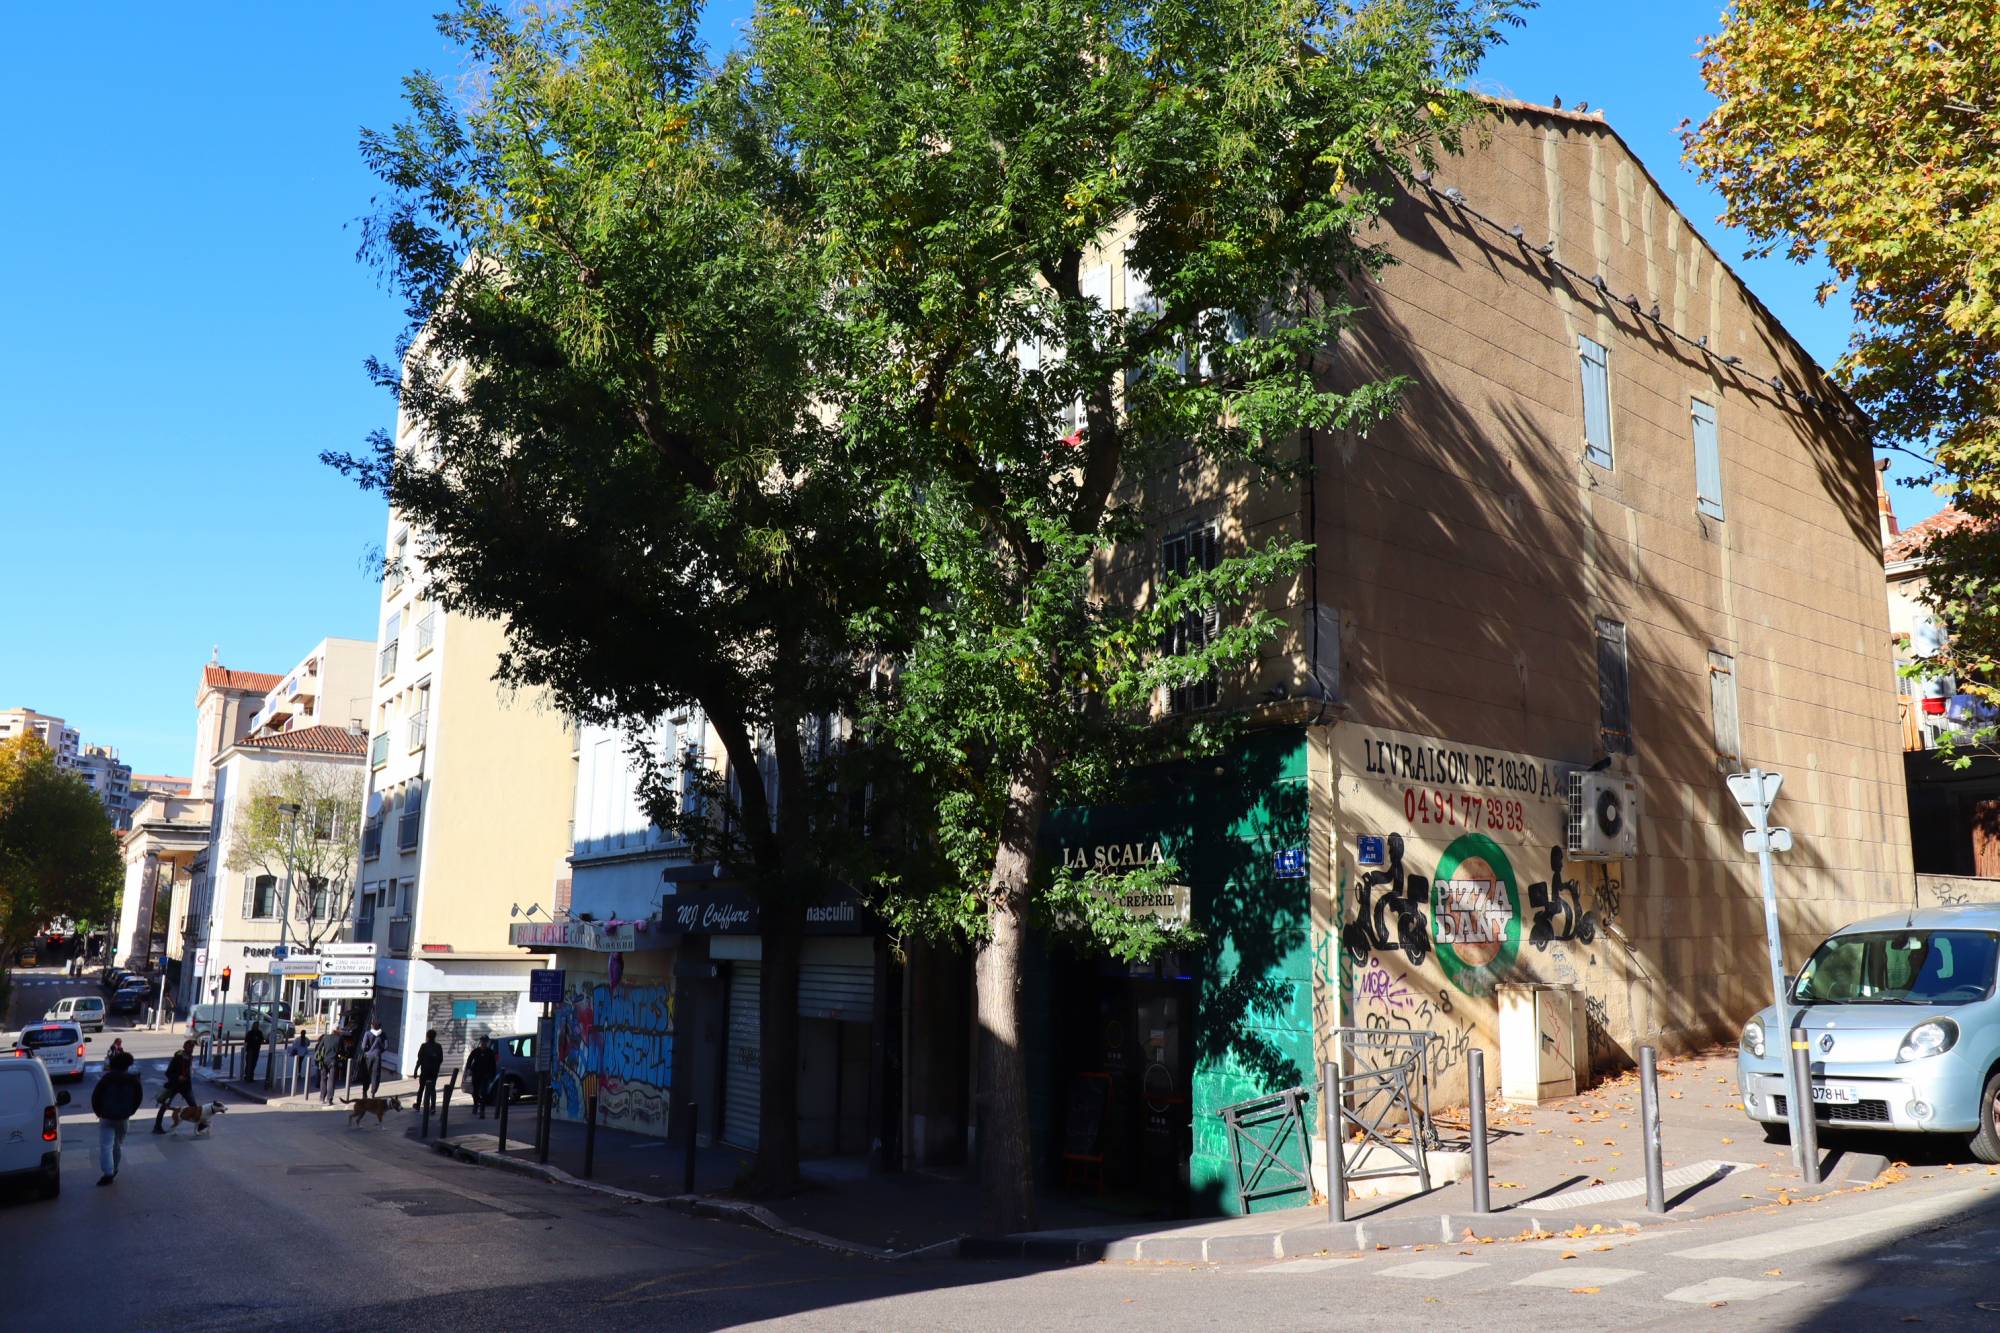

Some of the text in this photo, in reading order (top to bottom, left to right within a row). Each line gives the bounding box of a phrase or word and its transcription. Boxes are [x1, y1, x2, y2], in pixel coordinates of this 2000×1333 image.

[1364, 739, 1469, 786] LIVRAISON
[1475, 754, 1495, 787] DE
[1498, 757, 1537, 795] 18h30
[1540, 764, 1551, 797] A
[1404, 788, 1524, 833] 04 91 77 33 33
[1063, 841, 1165, 869] LA SCALA
[1434, 879, 1513, 915] PIZZA
[702, 903, 750, 930] Coiffure
[1435, 910, 1514, 944] DANY
